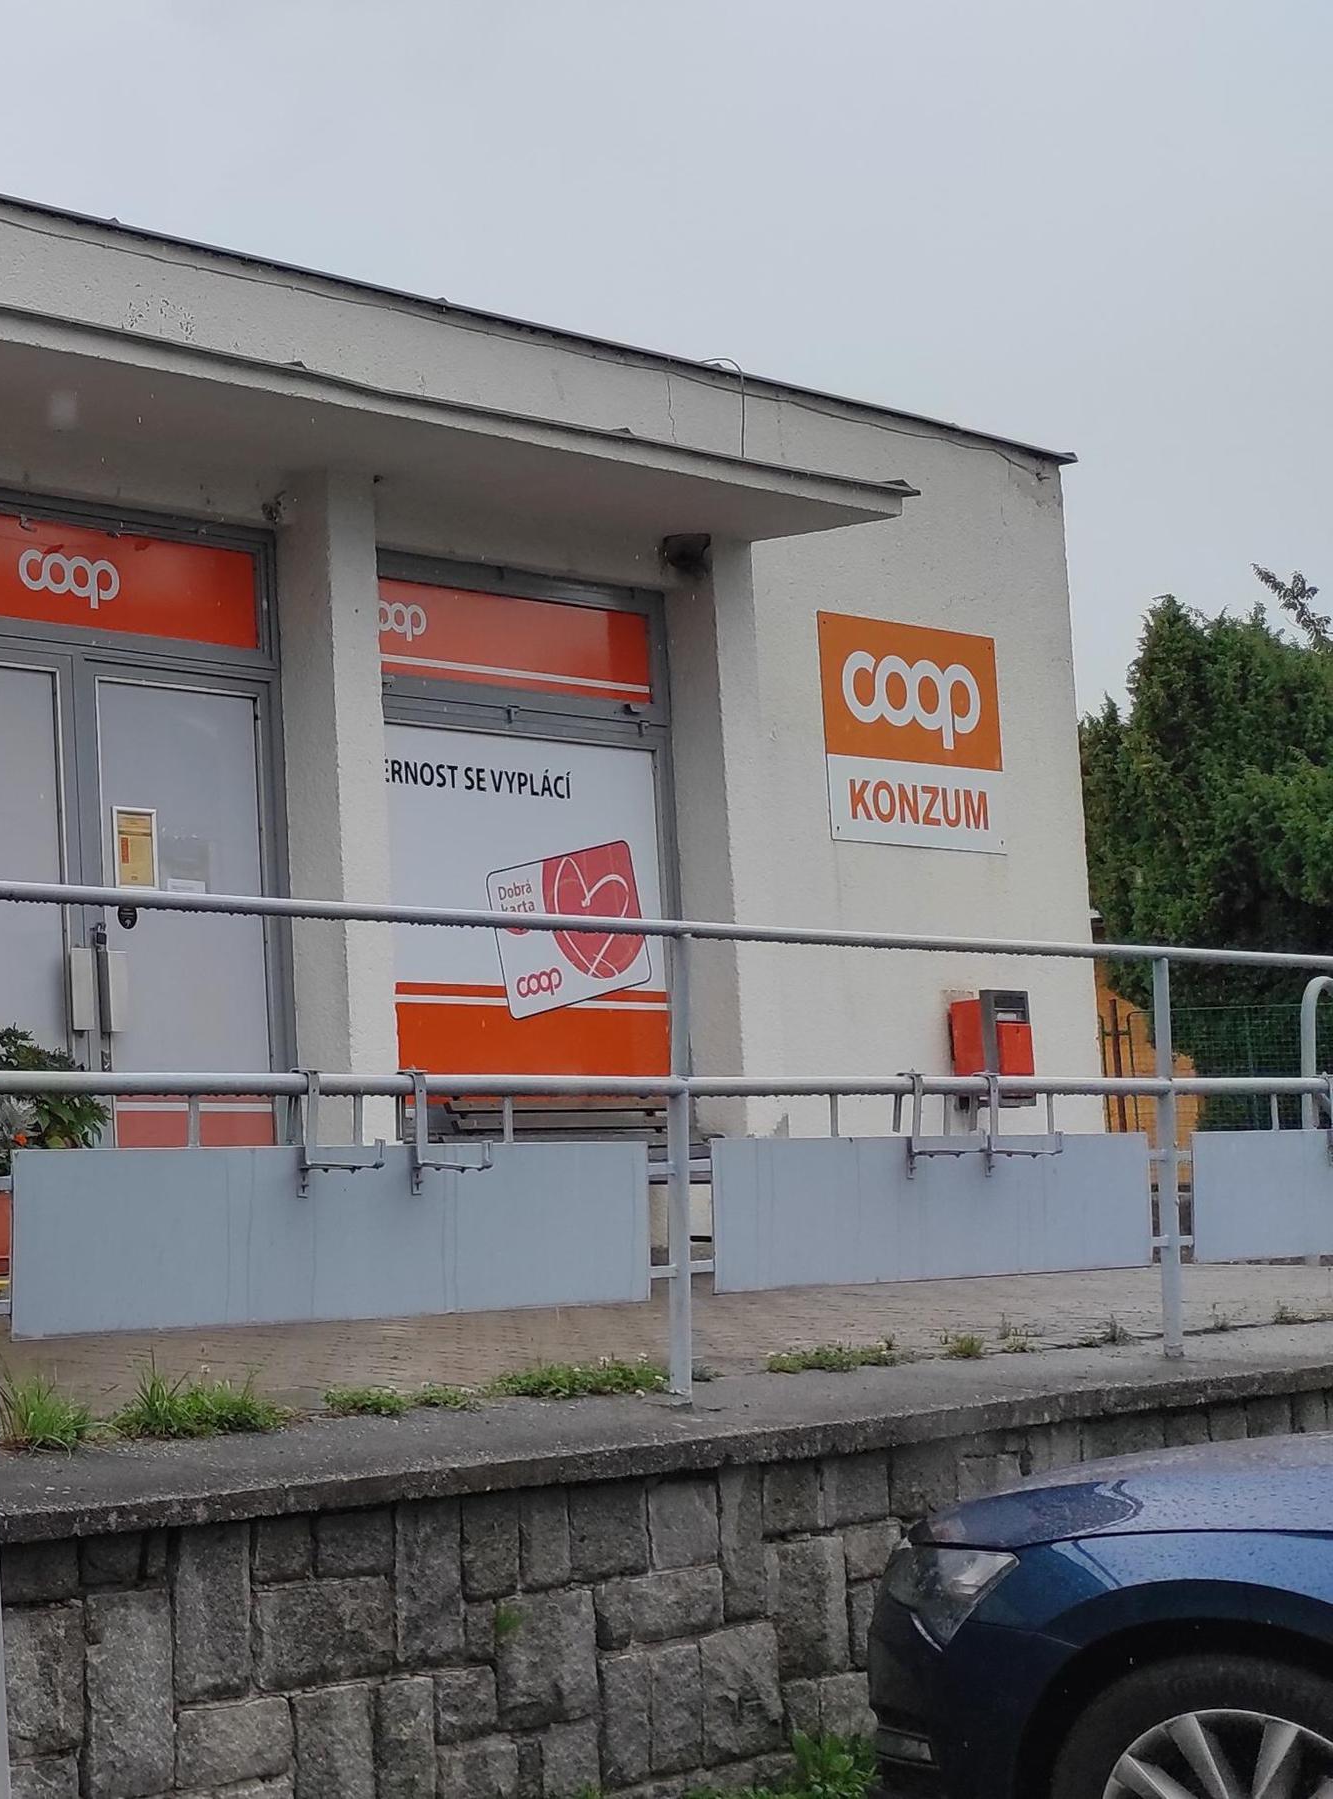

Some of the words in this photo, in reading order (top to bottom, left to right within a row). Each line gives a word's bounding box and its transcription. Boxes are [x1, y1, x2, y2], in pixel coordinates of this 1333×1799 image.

[19, 549, 120, 609] coop
[379, 600, 427, 641] oop
[842, 651, 981, 750] coop
[464, 766, 487, 791] SE
[491, 768, 572, 799] VYPLÁCÍ
[849, 778, 990, 831] KONZUM
[498, 880, 532, 900] Dobrá
[517, 968, 562, 998] coop
